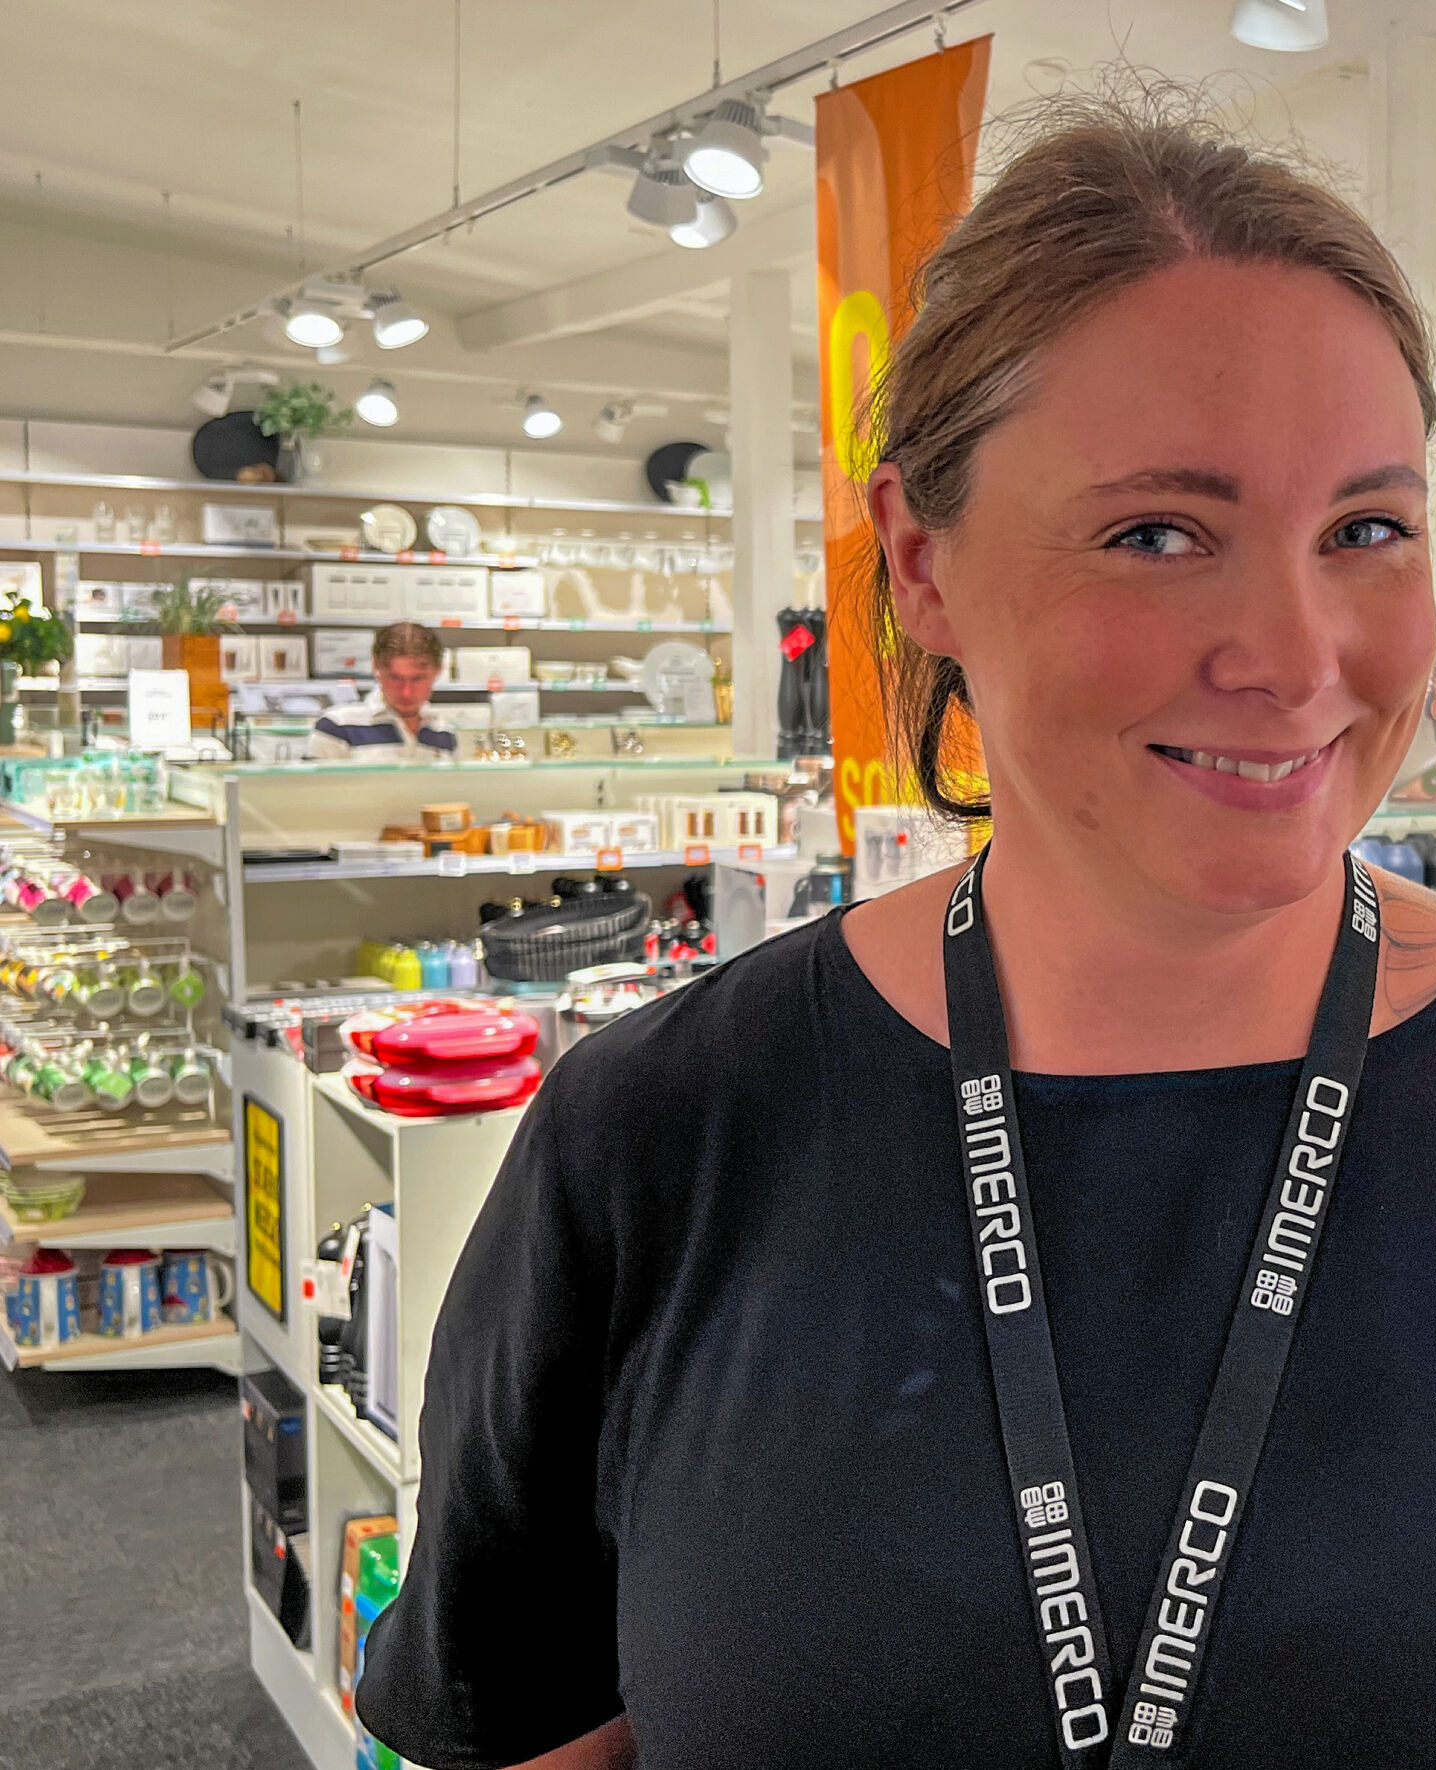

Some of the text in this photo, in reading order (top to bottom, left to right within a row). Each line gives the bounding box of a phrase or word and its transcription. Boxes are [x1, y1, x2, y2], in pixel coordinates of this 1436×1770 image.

[965, 1115, 1032, 1315] IMERCO
[1262, 1075, 1349, 1272] IMERCO
[1028, 1528, 1109, 1750] IMERCO
[1140, 1479, 1238, 1701] IMERCO
